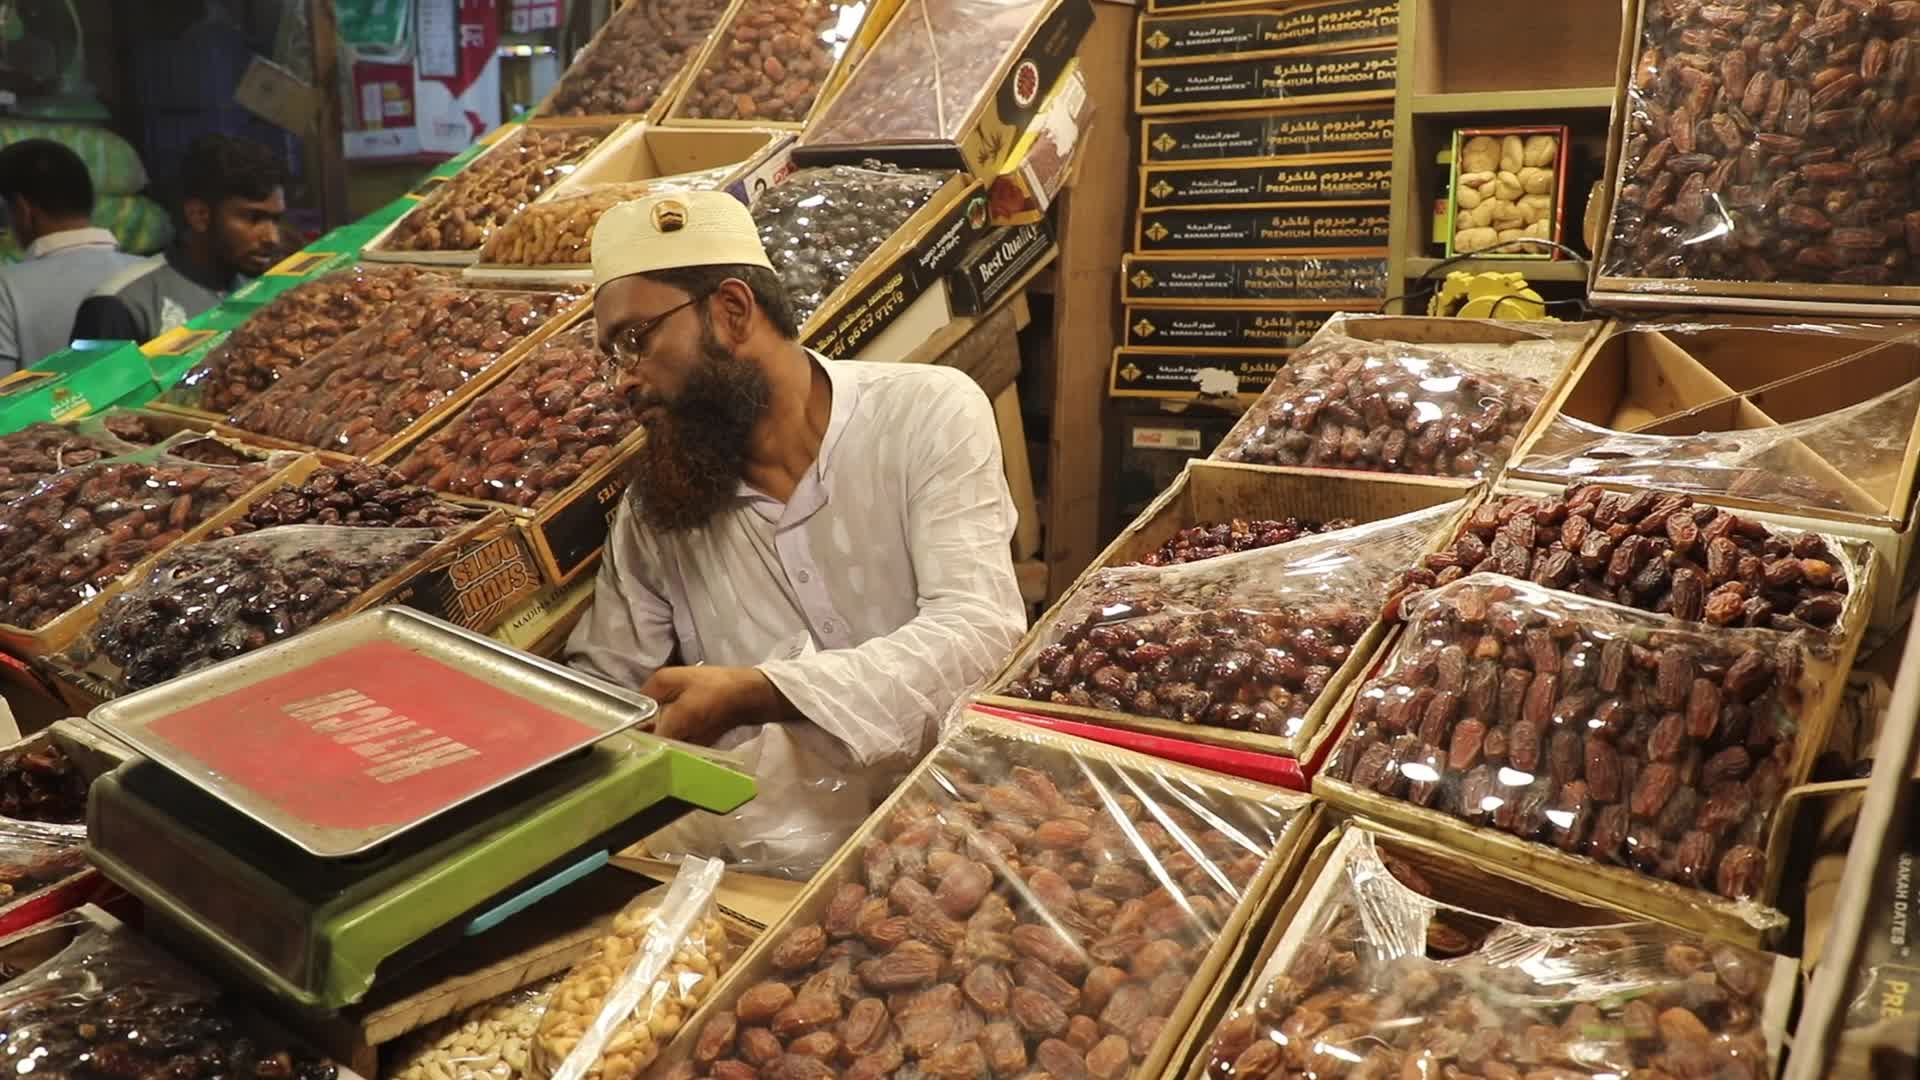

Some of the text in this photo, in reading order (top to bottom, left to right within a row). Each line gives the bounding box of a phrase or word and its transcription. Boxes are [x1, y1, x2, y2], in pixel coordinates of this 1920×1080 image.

[1264, 27, 1315, 41] PREMIUM
[1318, 19, 1377, 34] MABROOM
[1262, 77, 1313, 88] PREMIUM
[1316, 73, 1374, 85] MABROOM
[1270, 134, 1320, 145] PREMIUM
[1323, 131, 1379, 143] MABROOM
[1265, 184, 1317, 193] PREMIUM
[1320, 182, 1377, 193] MABROOM
[1261, 229, 1311, 239] PREMIUM
[1313, 228, 1370, 238] MABROOM
[979, 257, 1005, 283] Best
[1244, 279, 1293, 288] PREMIUM
[1296, 279, 1351, 288] MABROOM
[1244, 329, 1293, 337] PREMIUM
[450, 536, 520, 590] DATES
[460, 562, 528, 619] SAUDI
[280, 688, 481, 784] HITACHI
[1894, 850, 1913, 900] RAKAH
